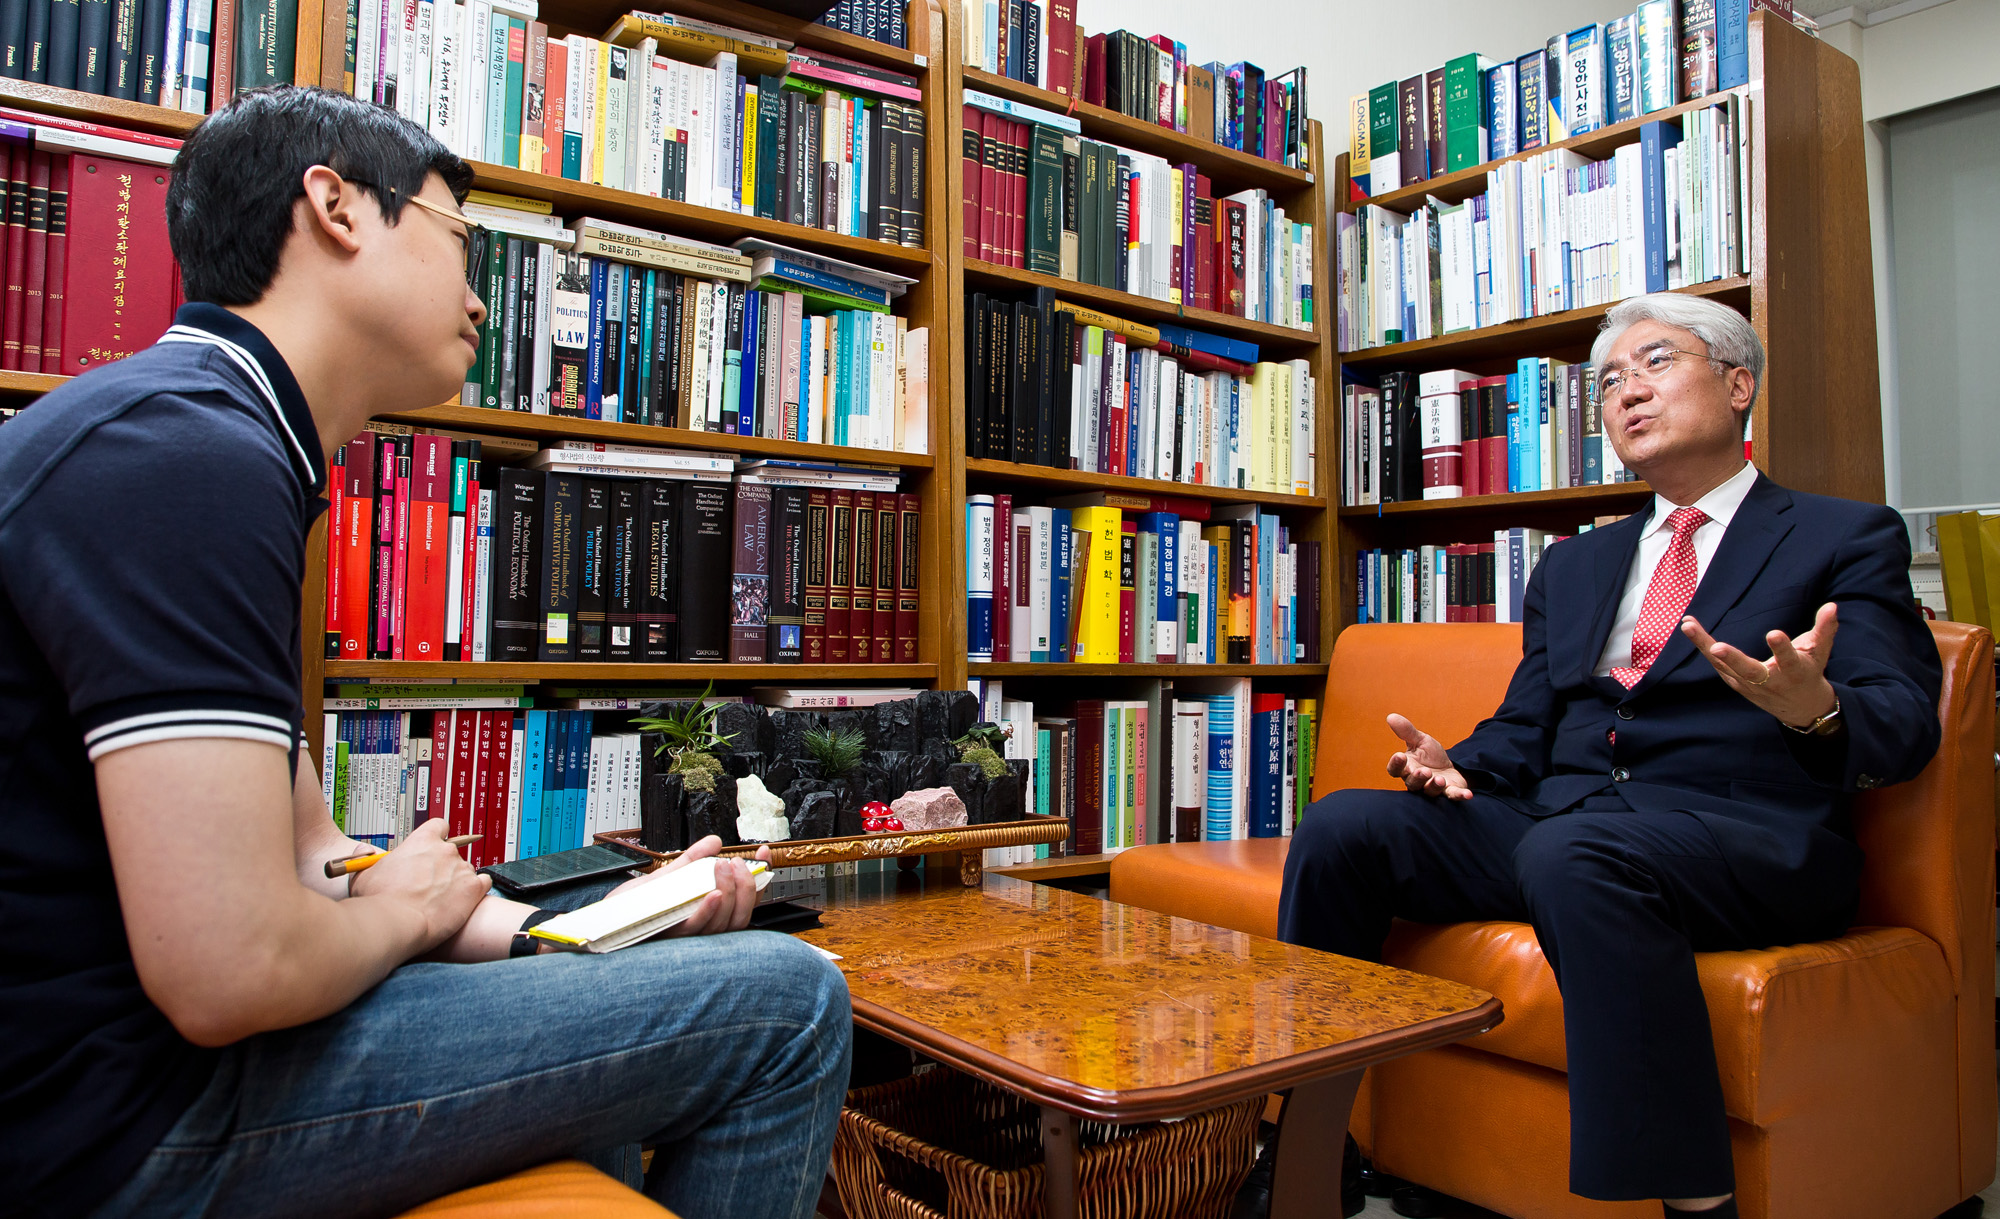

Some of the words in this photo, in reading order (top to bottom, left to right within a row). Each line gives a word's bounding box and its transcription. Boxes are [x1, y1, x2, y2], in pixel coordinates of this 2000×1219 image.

[1027, 6, 1037, 78] DICTIONARY
[87, 47, 97, 77] FURNELL
[145, 54, 155, 76] David
[1613, 47, 1632, 102] 영한사전
[143, 79, 153, 94] Bell
[1573, 58, 1589, 119] 영한사전
[1357, 97, 1366, 160] LONGMAN
[1524, 87, 1539, 139] 한영사전
[808, 135, 819, 175] Jefferson
[889, 142, 897, 195] JURISPRUDENCE
[911, 147, 919, 199] JURISPRUDENCE
[496, 276, 504, 309] Constitutional
[495, 310, 503, 328] Rights
[556, 306, 588, 319] POLITICS
[594, 299, 604, 340] Overruling
[557, 329, 586, 345] LAW
[788, 339, 801, 368] LAW
[591, 341, 602, 385] Democracy
[684, 343, 693, 407] DECISION-MAKING
[564, 364, 579, 409] GUARANTEED
[784, 374, 799, 401] Society
[385, 452, 393, 480] Legalines
[427, 443, 437, 476] emanuel
[456, 465, 465, 496] Legalines
[737, 491, 772, 502] COMPANION
[351, 500, 360, 537] Constitutional
[383, 506, 391, 531] Lockhart
[426, 505, 434, 539] Constitutional
[512, 511, 522, 555] POLITICAL
[523, 515, 531, 528] The
[551, 501, 562, 566] COMPARATIVE
[563, 513, 572, 527] The
[625, 516, 633, 530] The
[351, 537, 359, 547] Law
[521, 529, 530, 553] Oxford
[563, 528, 571, 552] Oxford
[586, 530, 594, 559] PUBLIC
[615, 525, 624, 559] UNITED
[624, 530, 632, 553] Oxford
[651, 521, 660, 553] LEGAL
[661, 533, 669, 557] Oxford
[744, 524, 754, 552] LAW
[755, 504, 767, 572] AMERICAN
[381, 551, 389, 603] CONSTITUTIONAL
[509, 556, 519, 601] ECONOMY
[520, 554, 529, 588] Handbook
[550, 566, 560, 607] POLITICS
[561, 553, 570, 589] Handbook
[584, 560, 593, 589] POLICY
[614, 560, 622, 598] NATIONS
[623, 554, 631, 588] Handbook
[650, 554, 659, 597] STUDIES
[660, 557, 668, 592] Handbook
[784, 553, 792, 604] CONSTITUTION
[518, 589, 527, 598] of
[560, 590, 569, 599] of
[623, 588, 629, 597] on
[658, 592, 667, 602] of
[460, 720, 470, 760] 서강법학
[481, 720, 491, 760] 서강법학
[498, 720, 508, 760] 서강법학
[1093, 797, 1100, 810] OF
